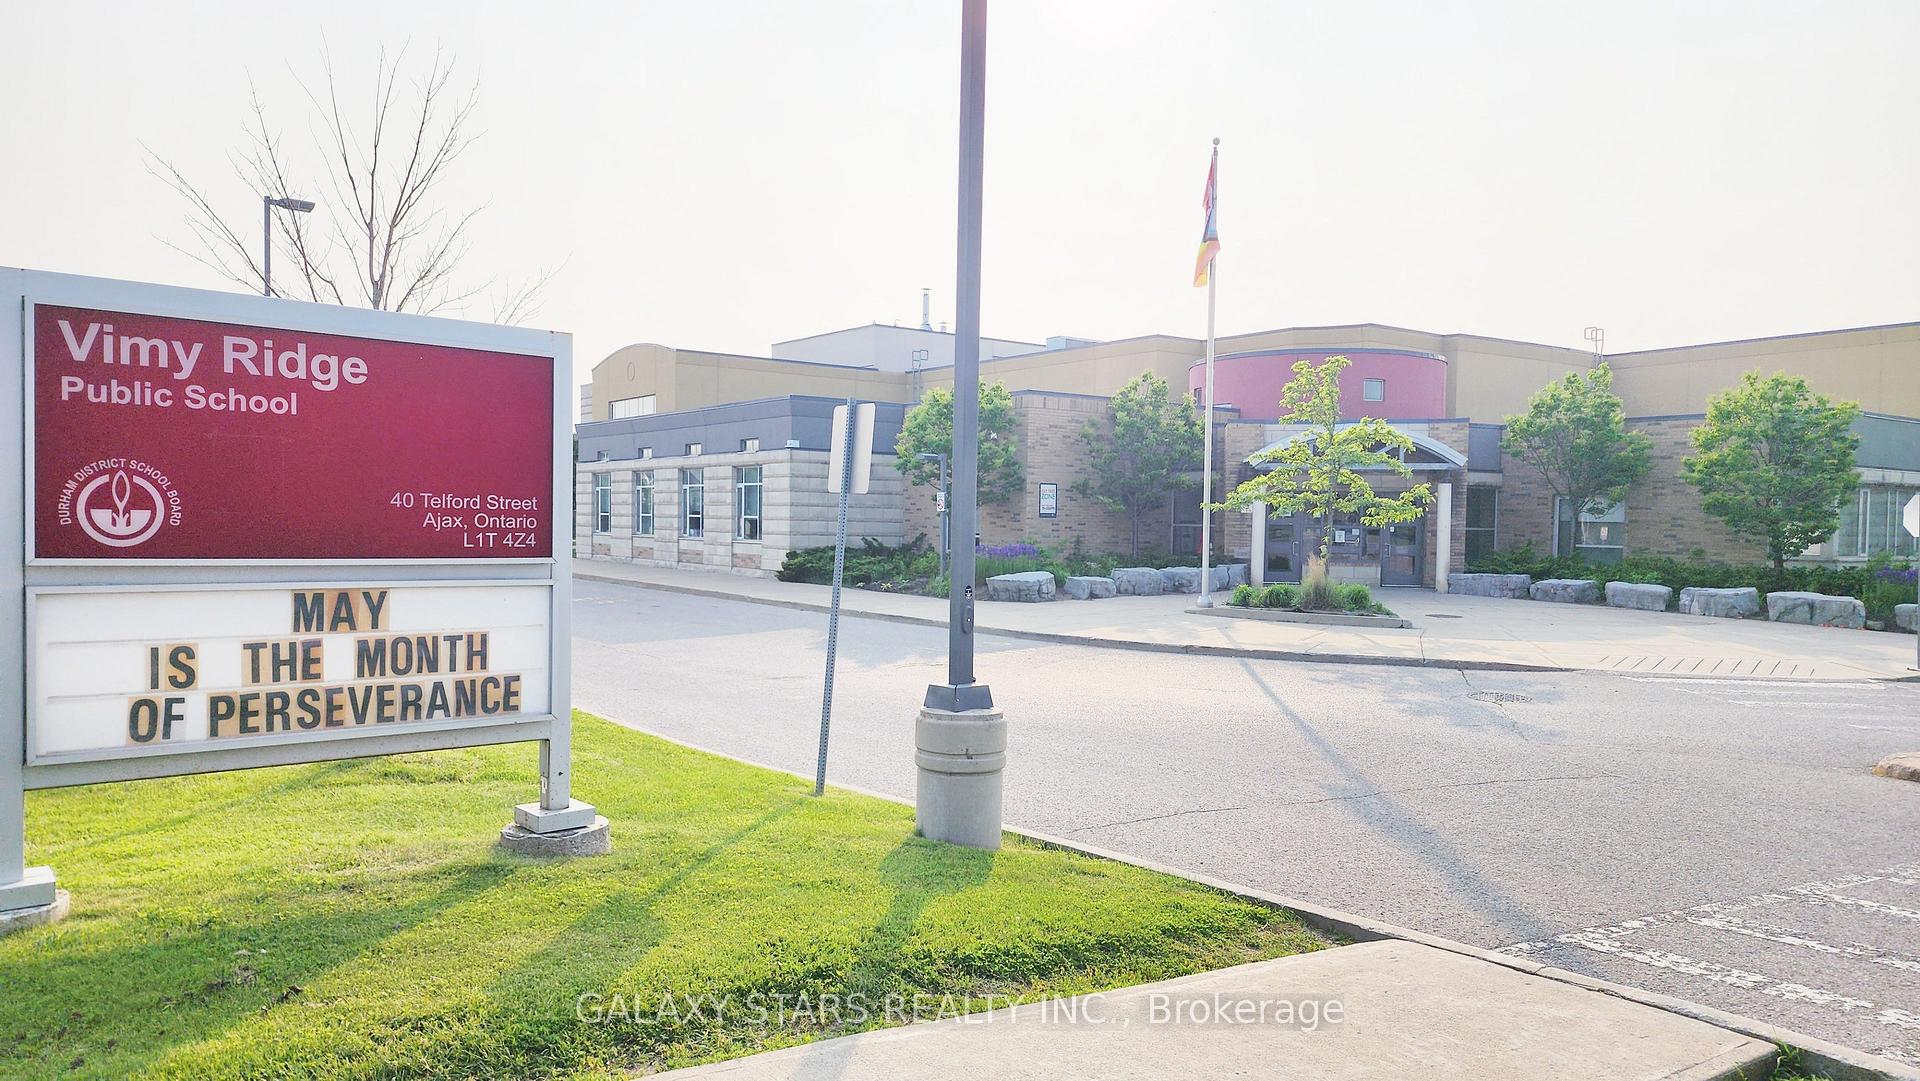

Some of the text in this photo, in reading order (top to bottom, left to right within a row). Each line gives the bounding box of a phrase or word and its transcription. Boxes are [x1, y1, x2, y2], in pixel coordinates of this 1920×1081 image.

[58, 319, 368, 391] Vimy Ridge
[61, 375, 297, 415] Public School
[58, 458, 181, 526] DURHAM DISTRICT SCHOOL BOARD
[390, 492, 538, 510] 40 Telford Street
[422, 512, 537, 531] Ajax, Ontario
[463, 532, 536, 547] L1T 4Z4
[293, 590, 388, 633] MAY
[150, 633, 488, 690] IS THE MONTH
[129, 674, 521, 743] OF PERSEVERANCE
